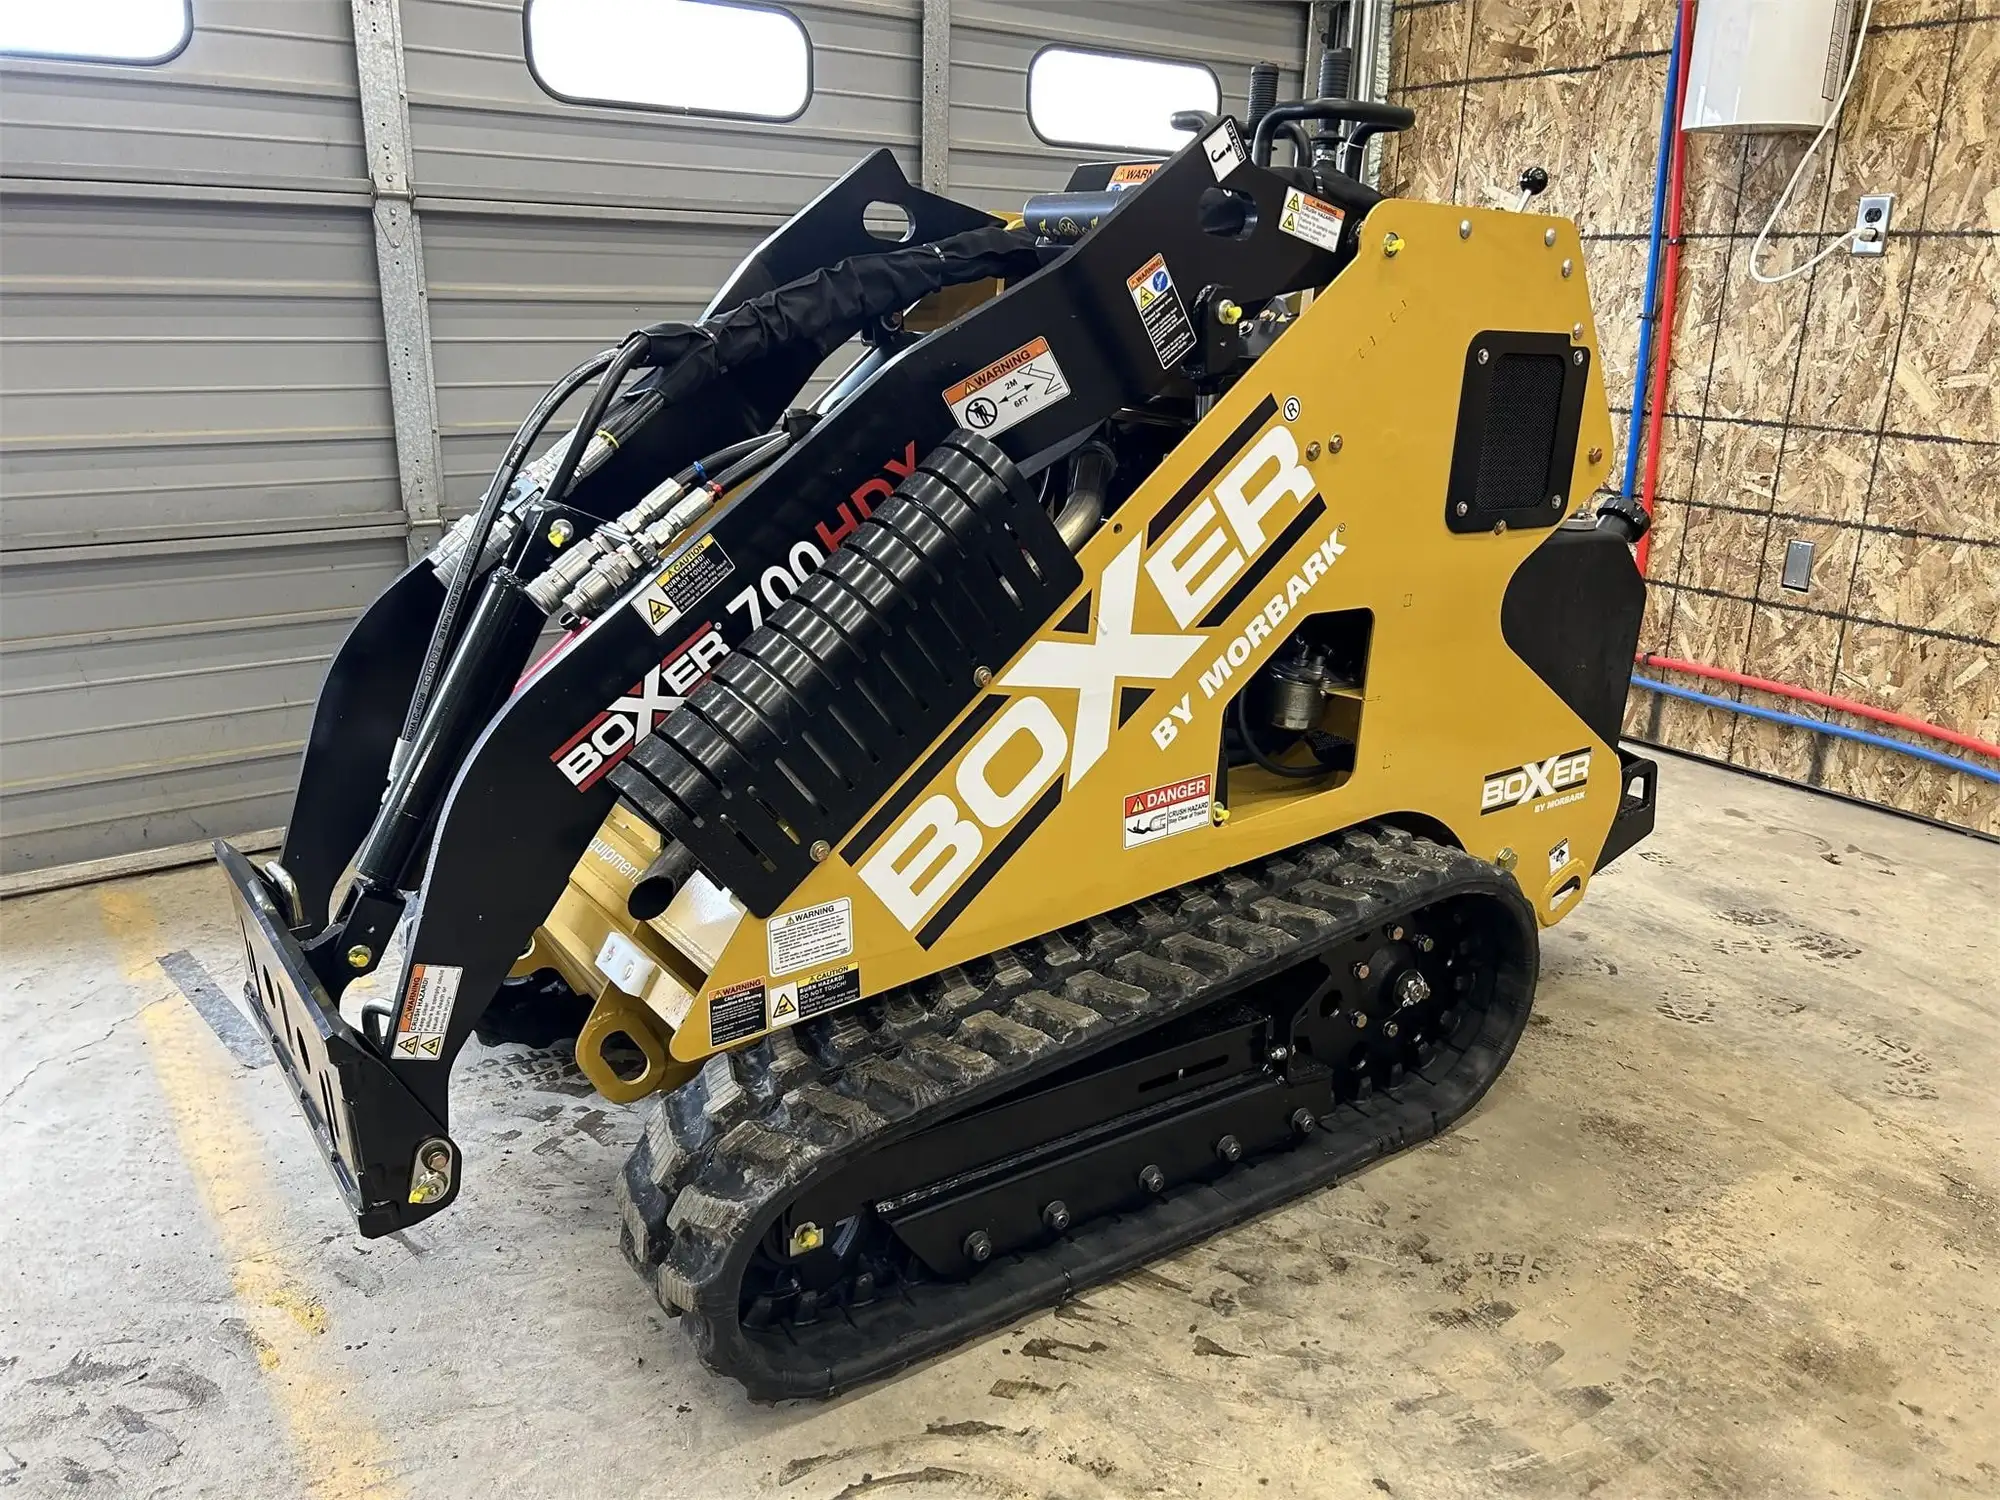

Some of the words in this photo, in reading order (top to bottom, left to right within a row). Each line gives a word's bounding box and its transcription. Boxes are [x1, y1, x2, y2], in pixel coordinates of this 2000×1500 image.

[1226, 123, 1235, 138] LIFT
[1232, 138, 1244, 160] POINT
[1136, 257, 1162, 284] WARNING
[974, 349, 1031, 387] WARNING
[1004, 379, 1018, 390] 2M
[1013, 395, 1029, 408] 6FT
[673, 543, 705, 572] CAUTION
[664, 576, 681, 591] BURN
[680, 554, 705, 577] HAZARD!
[669, 587, 679, 597] DO
[678, 577, 690, 589] NOT
[690, 558, 711, 578] TOUCH!
[1150, 692, 1193, 751] BY
[1197, 529, 1347, 699] MORBARK
[857, 425, 1317, 932] BOXER
[557, 630, 731, 786] BOXER
[1147, 779, 1206, 807] DANGER
[1481, 754, 1591, 808] BOXER
[1169, 808, 1186, 818] CRUSH
[1188, 801, 1208, 813] HAZARD
[1535, 803, 1545, 813] BY
[1547, 791, 1585, 808] MORBARK
[795, 905, 834, 922] WARNING
[723, 979, 761, 995] WARNING
[800, 984, 817, 993] BURN
[818, 975, 844, 987] HAZARD!
[817, 966, 848, 981] CAUTION
[407, 978, 420, 1011] WARNING
[811, 988, 823, 996] NOT
[825, 981, 846, 992] TOUCH!
[411, 1009, 421, 1030] CRUSH
[417, 978, 429, 1006] HAZARD!
